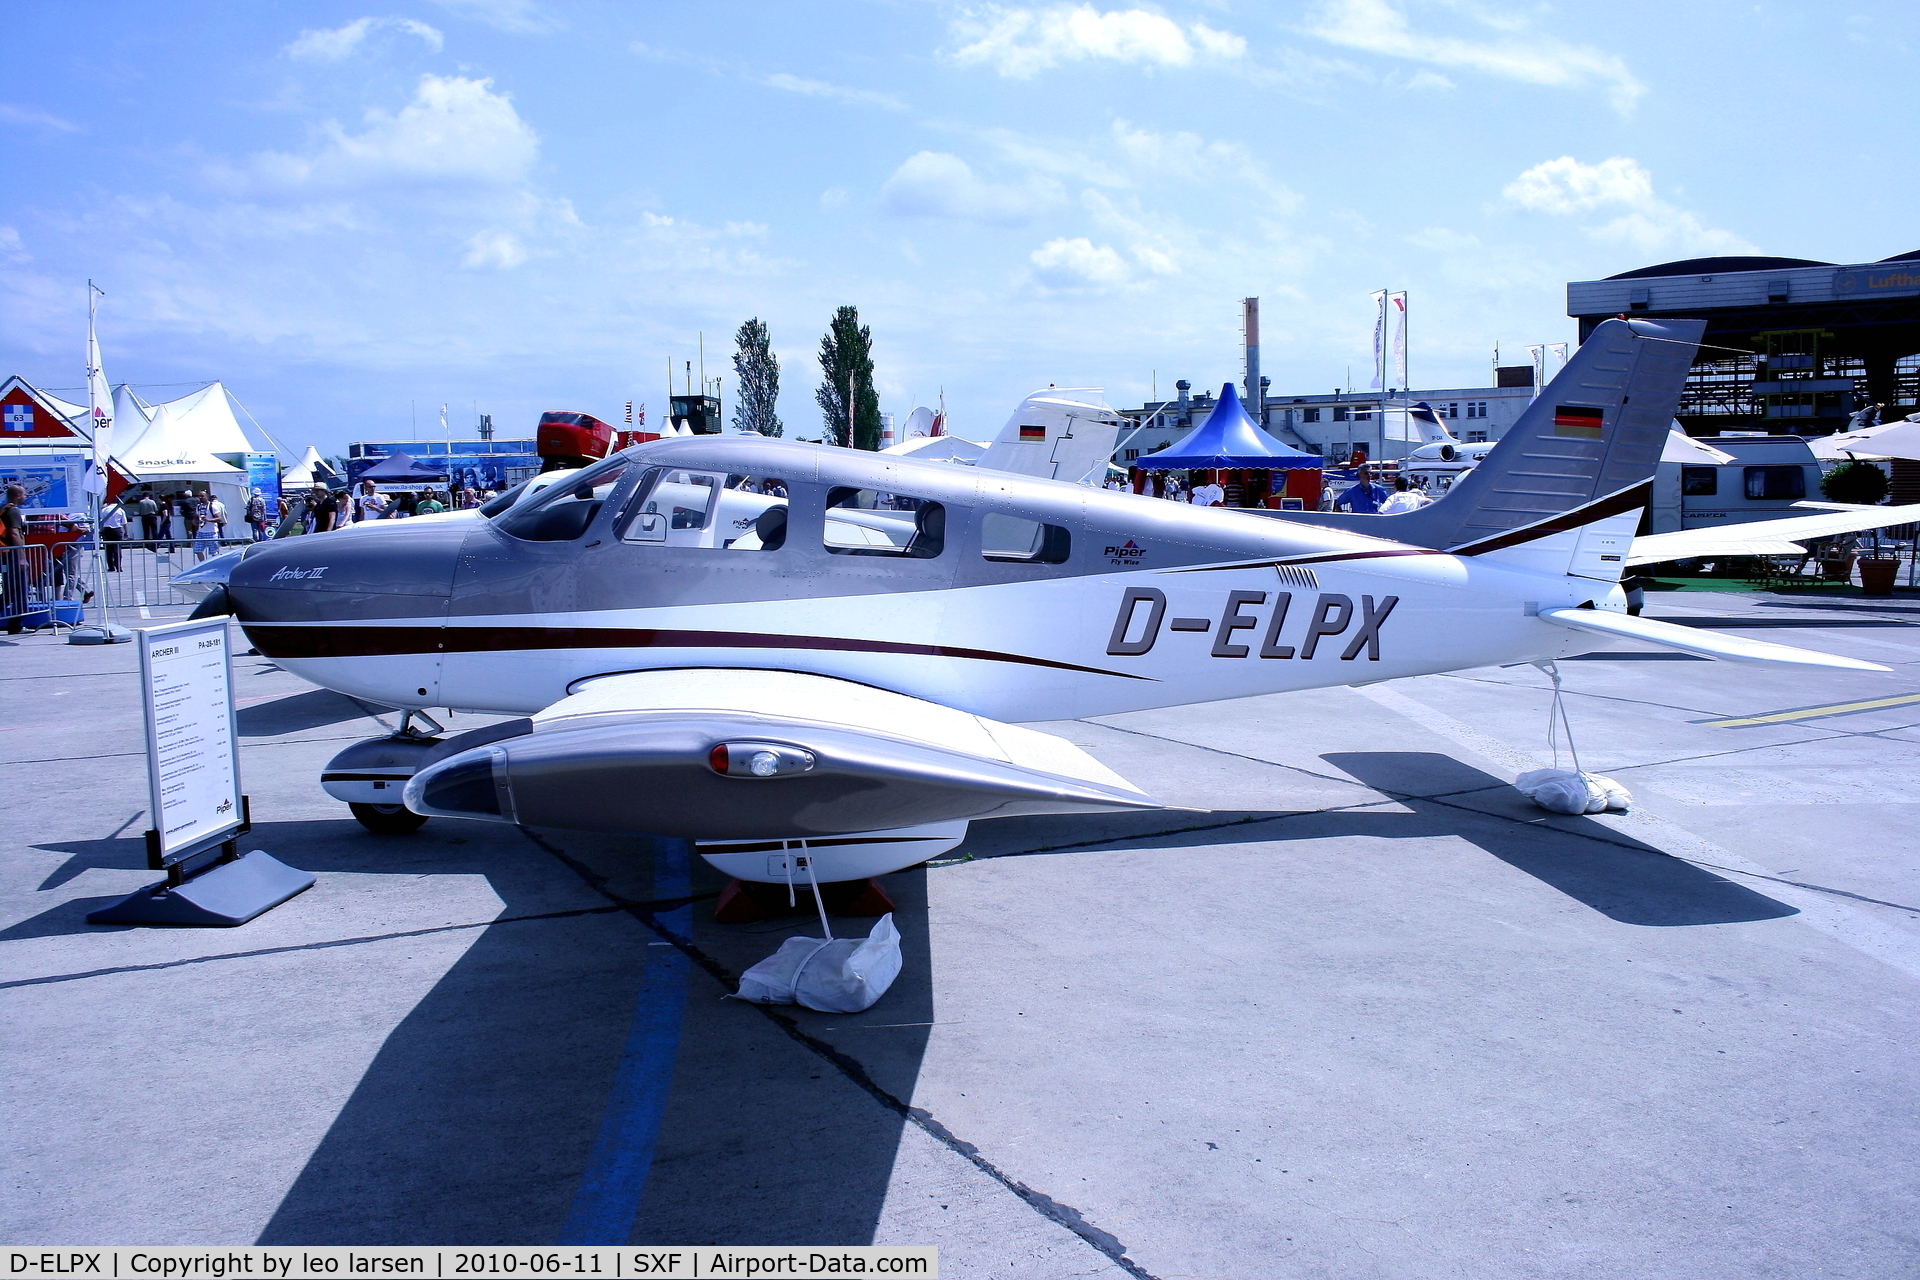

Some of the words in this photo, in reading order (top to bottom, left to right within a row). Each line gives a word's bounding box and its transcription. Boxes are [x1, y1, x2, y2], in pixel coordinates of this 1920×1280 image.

[13, 414, 24, 422] 63
[1104, 546, 1147, 558] Piper
[269, 565, 311, 582] Archer
[307, 566, 329, 579] III
[1106, 586, 1400, 662] D-ELPX
[152, 647, 174, 659] ARCHER
[198, 638, 221, 649] PA-28-181
[216, 802, 233, 815] Piper
